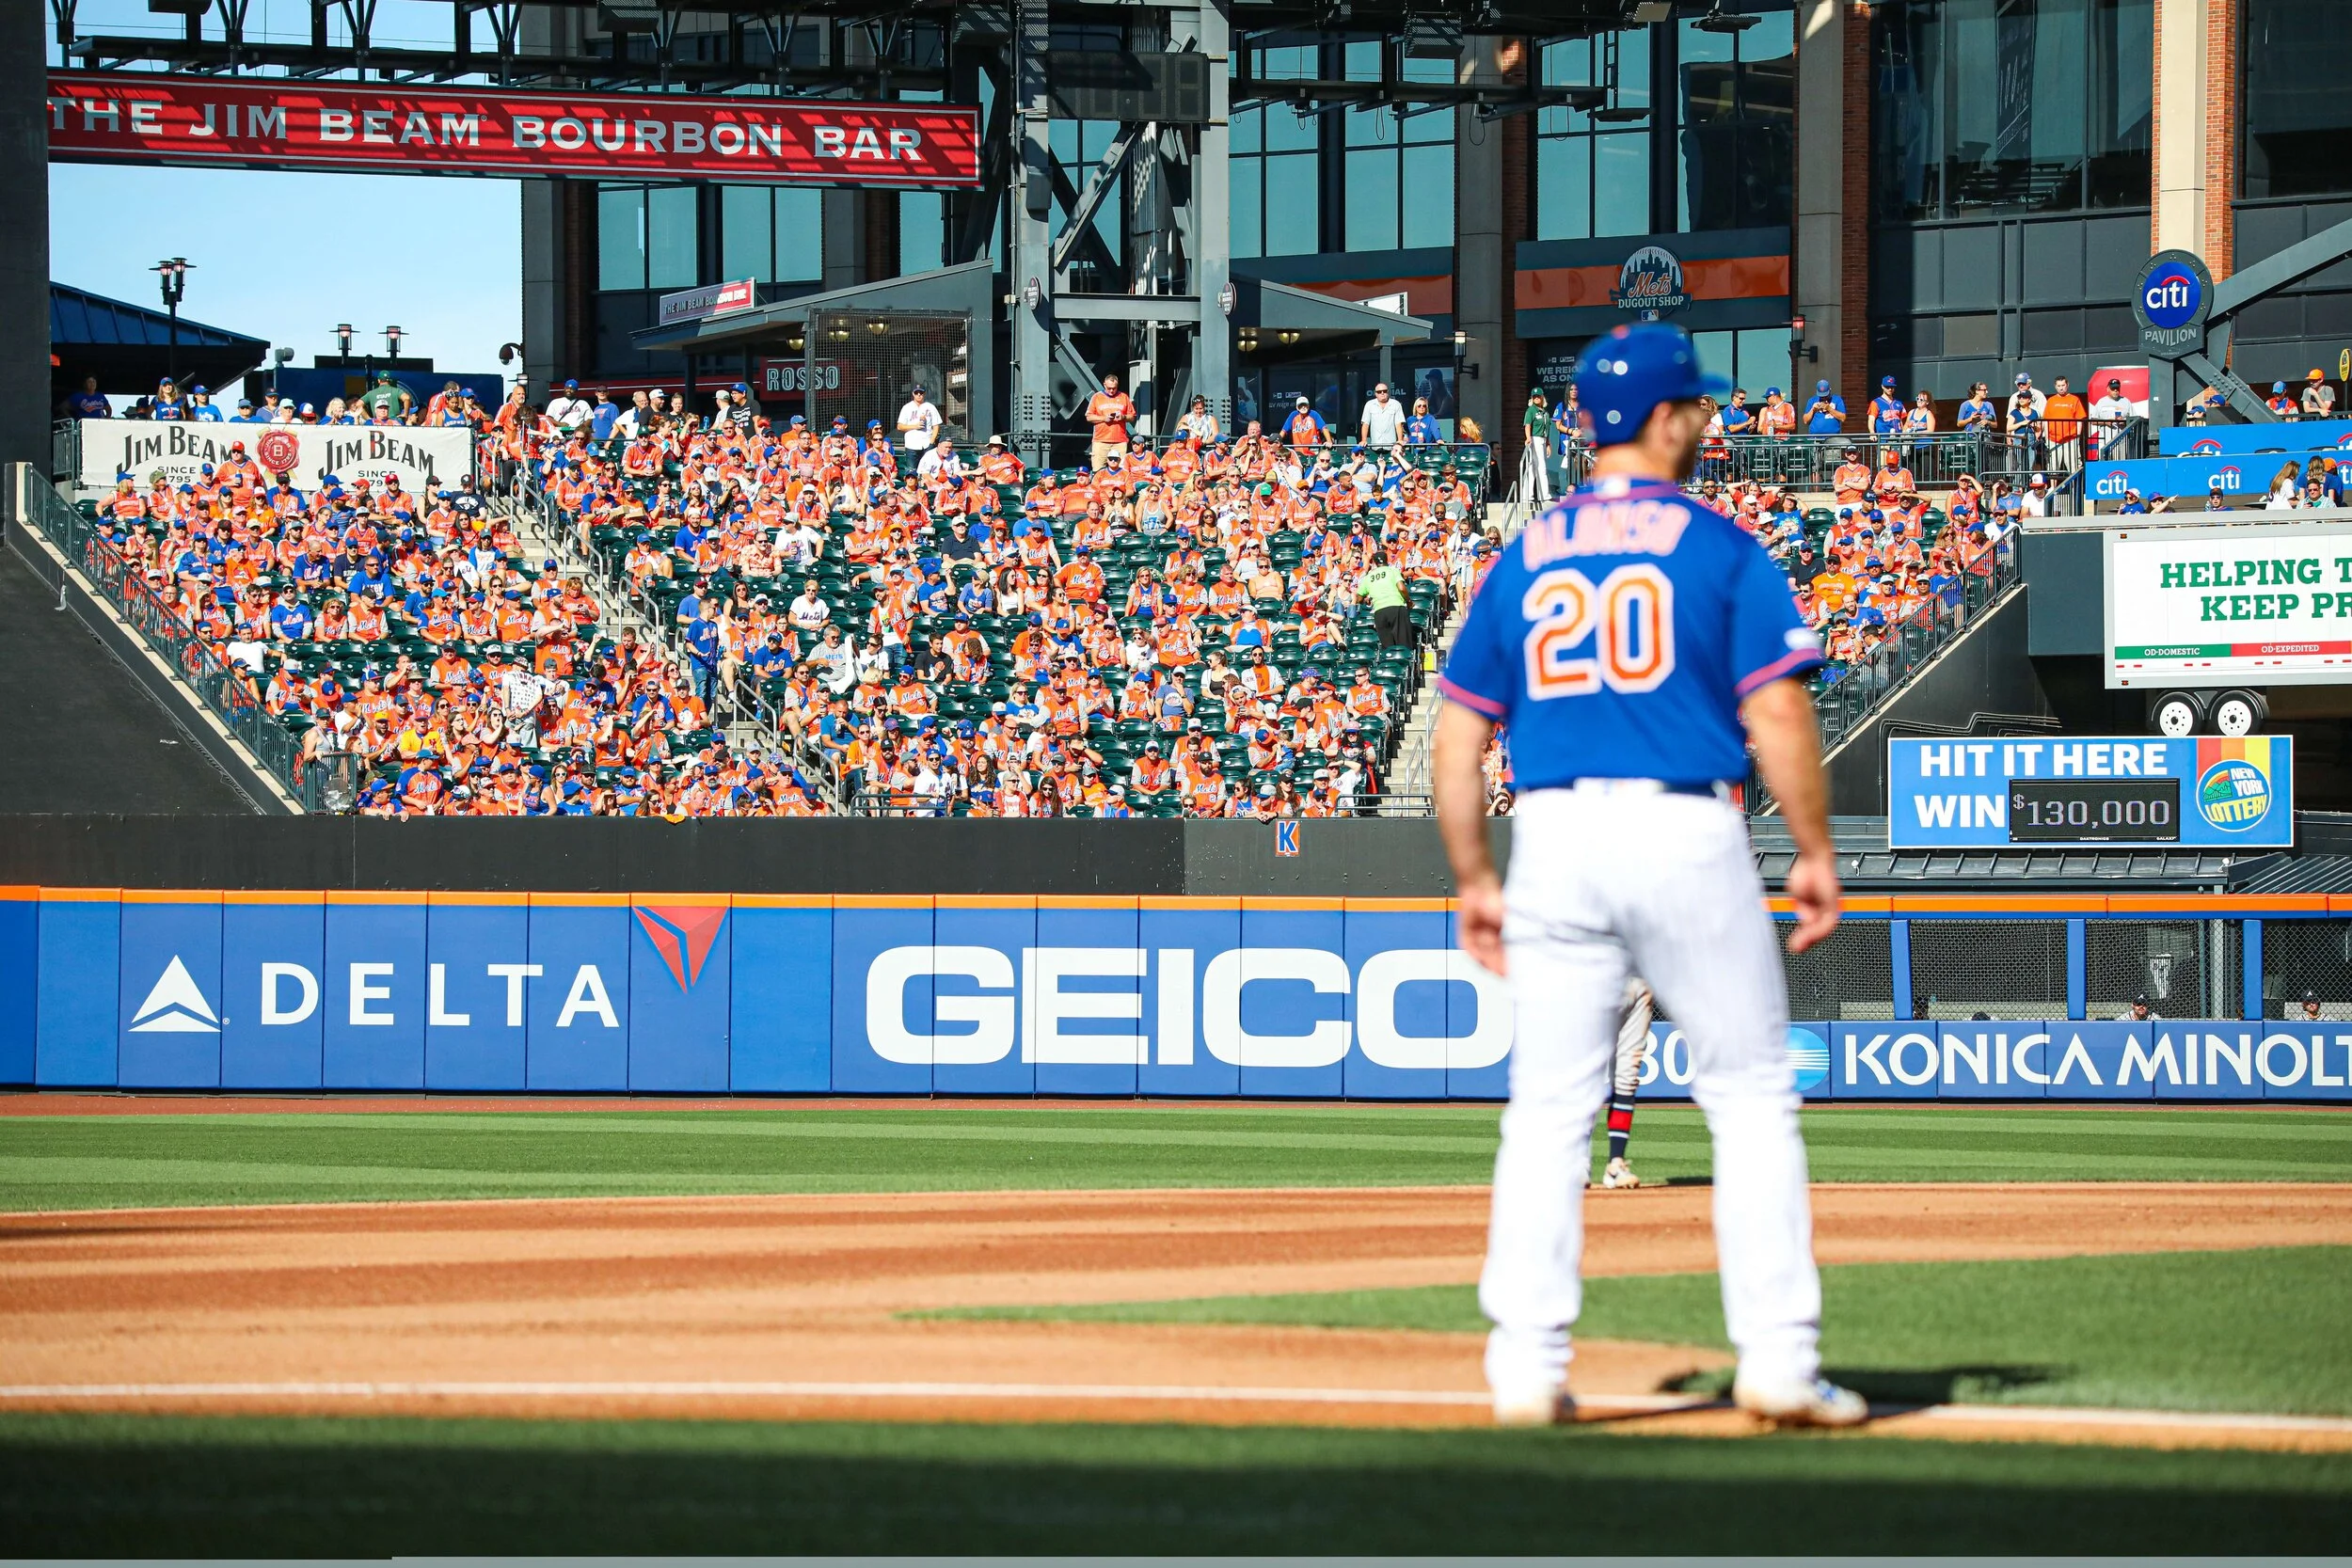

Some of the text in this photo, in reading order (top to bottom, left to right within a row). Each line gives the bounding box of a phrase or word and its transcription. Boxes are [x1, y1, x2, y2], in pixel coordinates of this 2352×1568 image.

[48, 96, 922, 162] THE JIM BEAM BOURBON BAR
[1628, 272, 1673, 298] Mets
[2146, 280, 2189, 309] citi
[665, 303, 675, 314] THE
[676, 300, 687, 312] JIM
[688, 296, 705, 310] BEAM
[1618, 295, 1684, 309] DUGOUT SHOP
[2145, 328, 2197, 347] PAVILION
[767, 366, 839, 391] ROSSO
[1555, 365, 1581, 374] REIG
[910, 410, 930, 422] Mts
[117, 426, 232, 472] JIM BEAM
[318, 431, 435, 480] JIM BEAM
[157, 466, 196, 474] SINCE
[168, 475, 191, 483] 795
[2208, 469, 2240, 490] citi
[2096, 474, 2127, 495] citi
[1370, 572, 1386, 583] 309
[2160, 559, 2322, 588] HELPING
[799, 611, 819, 621] Mets
[2201, 594, 2299, 621] KEEP
[1522, 562, 1675, 702] 20
[1920, 743, 2168, 777] HIT IT HERE
[2231, 768, 2256, 781] NEW
[2233, 780, 2265, 797] YORK
[1914, 793, 2169, 830] WIN $130,000
[2204, 795, 2267, 823] LOTTERY
[1278, 820, 1299, 853] K
[261, 961, 620, 1027] DELTA
[866, 945, 1515, 1069] GEICO
[1845, 1034, 2104, 1085] KONICA
